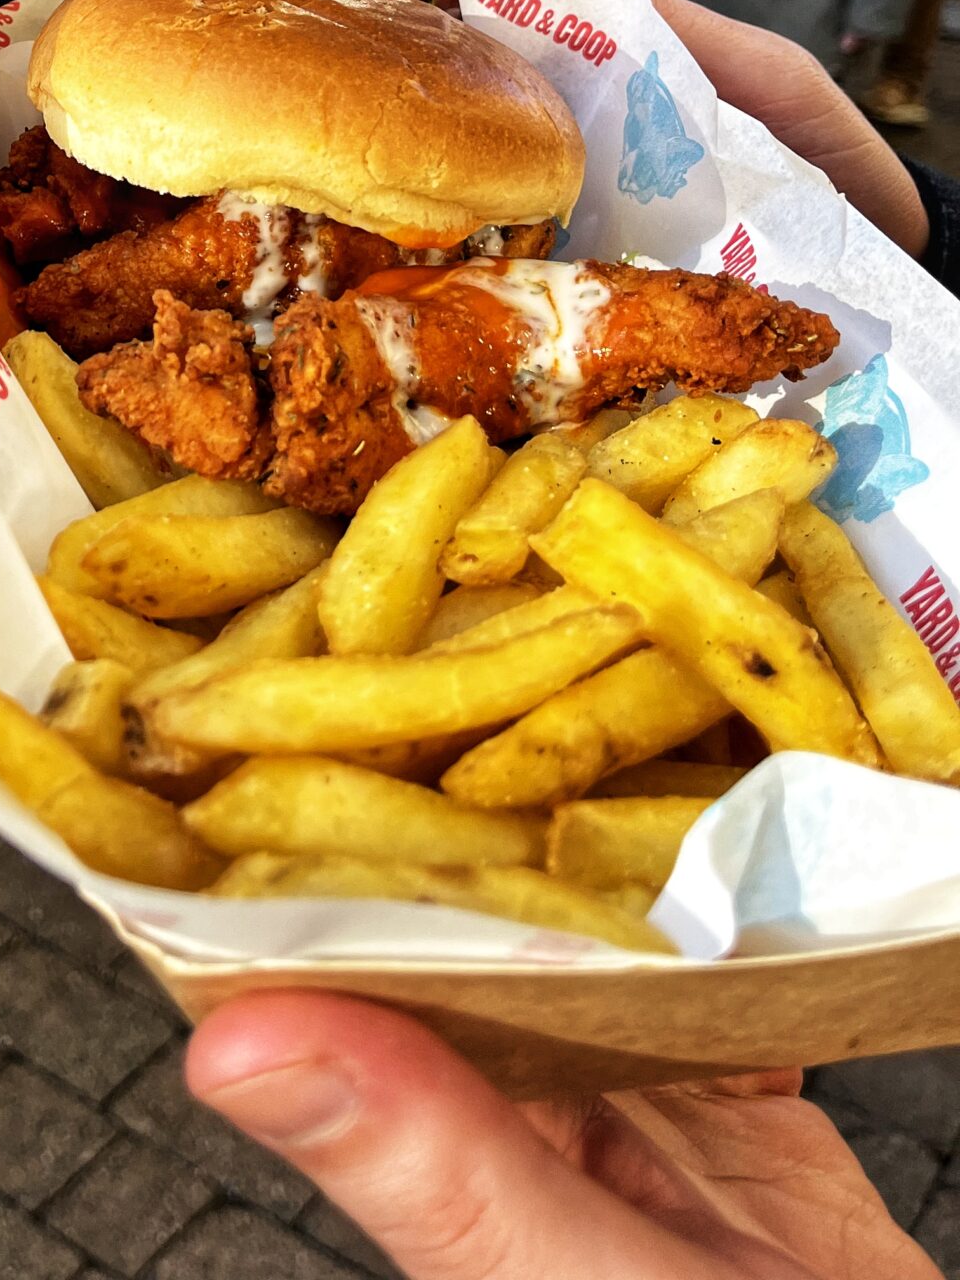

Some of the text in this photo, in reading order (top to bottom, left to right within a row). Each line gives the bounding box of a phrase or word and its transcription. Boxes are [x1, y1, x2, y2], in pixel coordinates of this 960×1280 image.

[534, 9, 555, 36] &
[552, 13, 617, 67] COOP
[720, 222, 758, 278] YARD
[899, 565, 960, 678] YARD &
